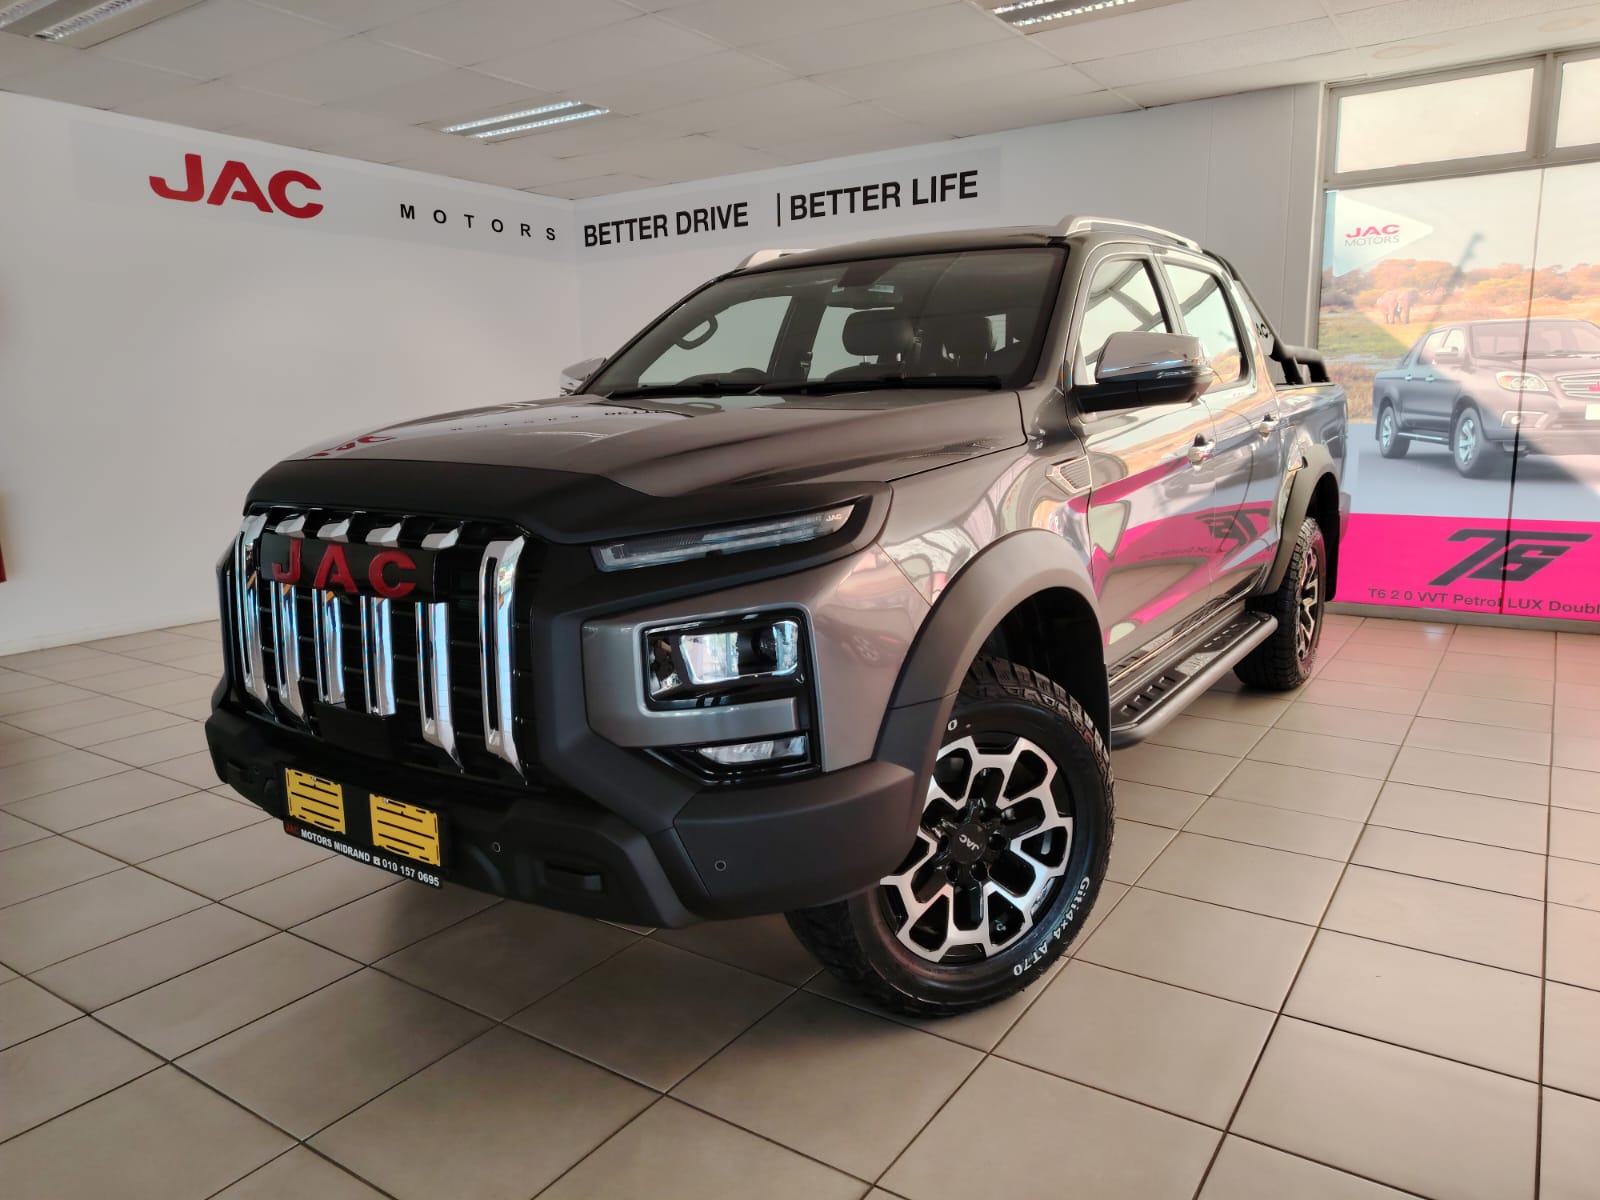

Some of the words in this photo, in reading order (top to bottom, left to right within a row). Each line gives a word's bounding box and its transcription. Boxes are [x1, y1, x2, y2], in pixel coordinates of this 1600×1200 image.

[149, 153, 324, 219] JAC
[400, 203, 556, 241] MOTORS
[584, 213, 668, 247] BETTER
[676, 201, 749, 235] DRIVE
[790, 181, 901, 221] BETTER
[912, 170, 978, 206] LIFE
[1344, 235, 1400, 247] MOTORS
[1346, 224, 1400, 238] JAC
[273, 537, 417, 598] JAC
[1368, 588, 1386, 599] T6
[1417, 592, 1448, 603] VVT
[1453, 594, 1502, 608] Petrol
[1508, 598, 1542, 610] LUX
[301, 828, 332, 848] MOTORS
[334, 841, 370, 863] MIDRAND
[382, 858, 398, 872] 010
[400, 865, 415, 878] 157
[417, 871, 440, 887] 0695
[959, 834, 979, 851] JAC
[1013, 942, 1048, 976] AT70
